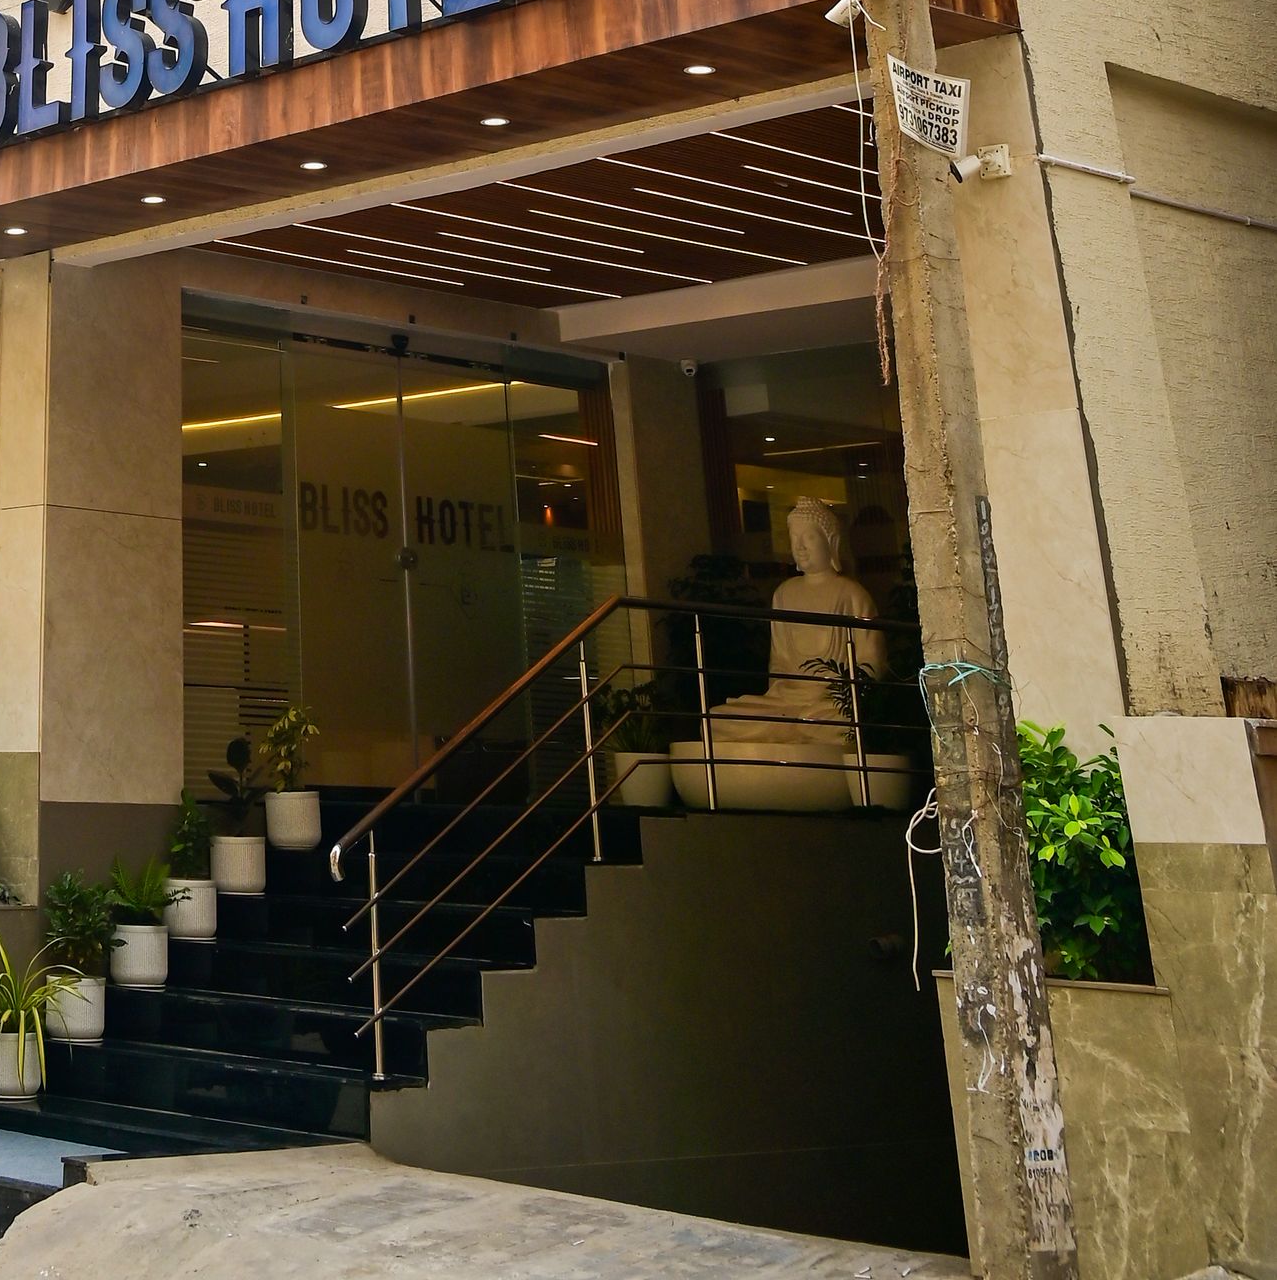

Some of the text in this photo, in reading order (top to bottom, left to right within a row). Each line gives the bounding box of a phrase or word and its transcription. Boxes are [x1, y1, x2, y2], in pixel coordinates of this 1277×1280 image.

[892, 61, 962, 98] AIRPORT TAXI
[896, 84, 919, 105] Airport
[920, 99, 960, 117] PICKUP
[928, 111, 959, 127] DROP
[898, 104, 958, 146] 9731067383
[300, 481, 516, 554] BLISS HOTEL
